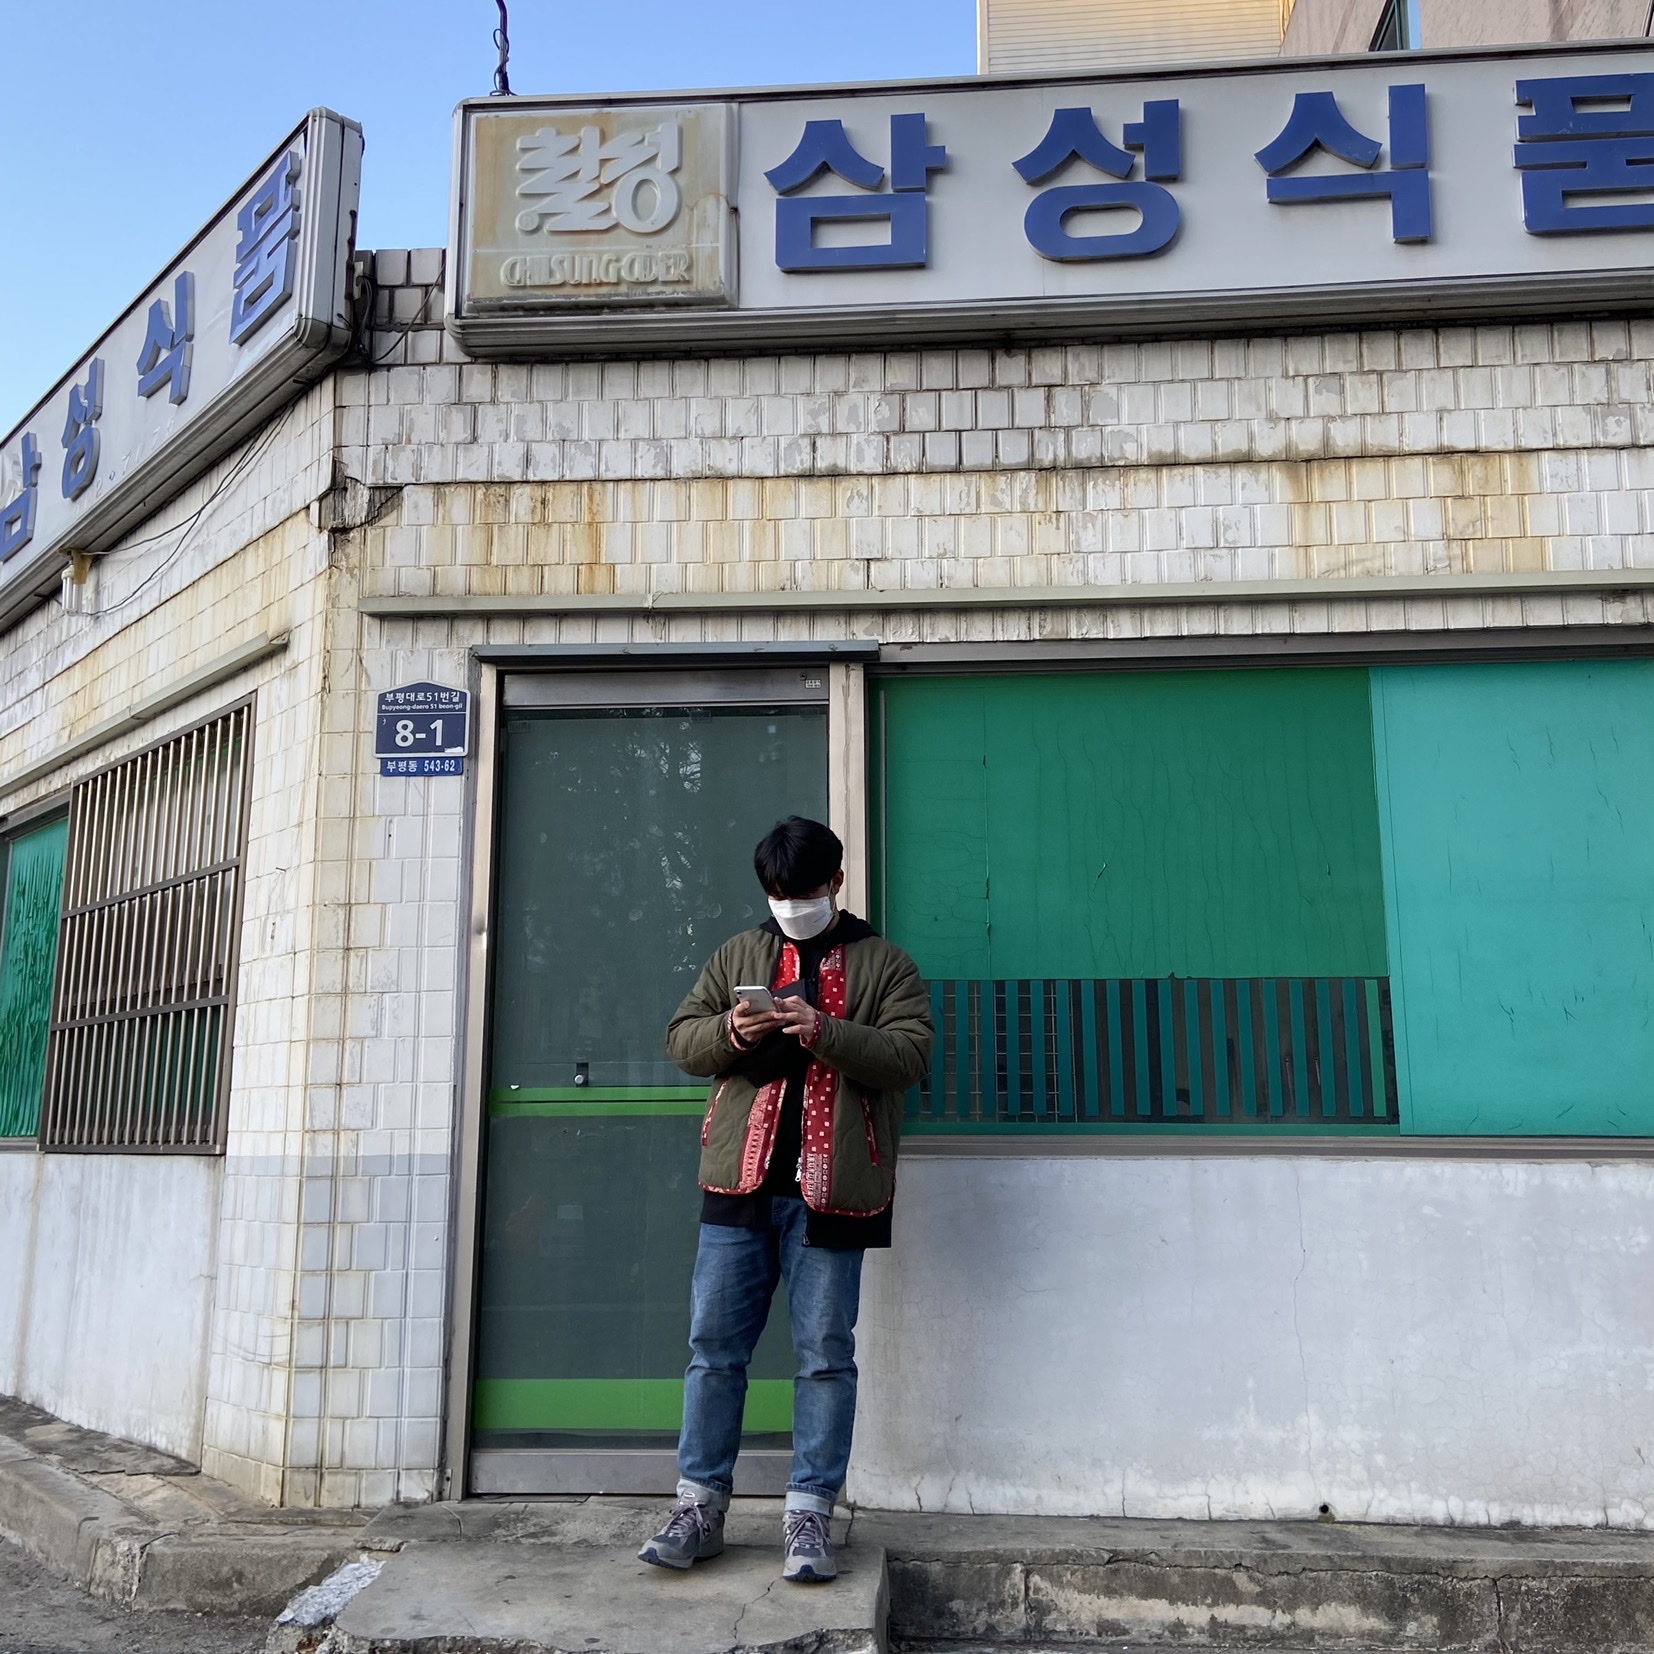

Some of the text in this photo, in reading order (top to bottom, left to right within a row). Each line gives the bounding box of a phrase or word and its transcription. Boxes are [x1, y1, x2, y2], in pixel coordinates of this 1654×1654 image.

[763, 73, 1654, 272] 삼성식품
[385, 692, 460, 703] 부평대로51번길
[381, 703, 429, 711] Bupyeong-daero
[395, 719, 443, 747] 8-1
[386, 760, 417, 773] 부평동
